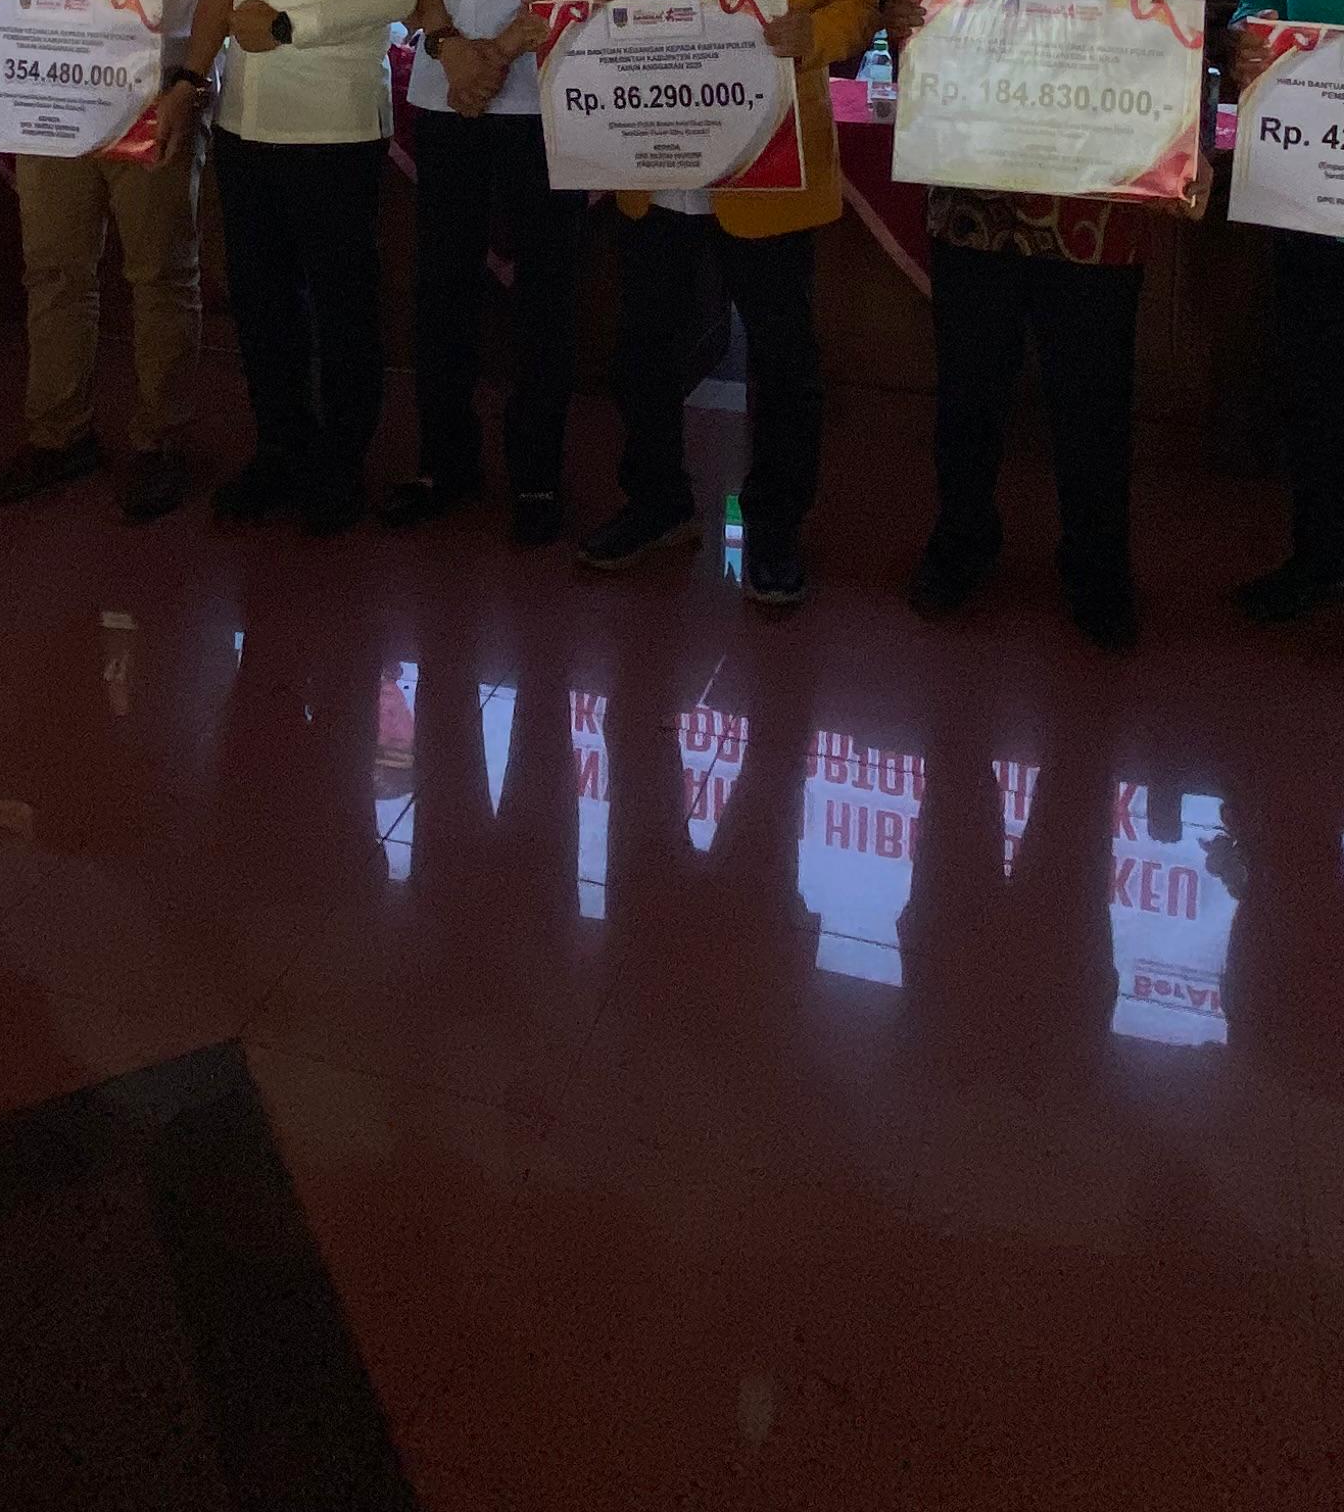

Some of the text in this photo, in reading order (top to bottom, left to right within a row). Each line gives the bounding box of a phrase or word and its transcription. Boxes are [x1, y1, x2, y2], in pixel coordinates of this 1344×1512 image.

[4, 58, 142, 92] 354.480.000,-
[565, 81, 764, 115] Rp. 86.290.000,-
[1259, 116, 1310, 150] Rp.
